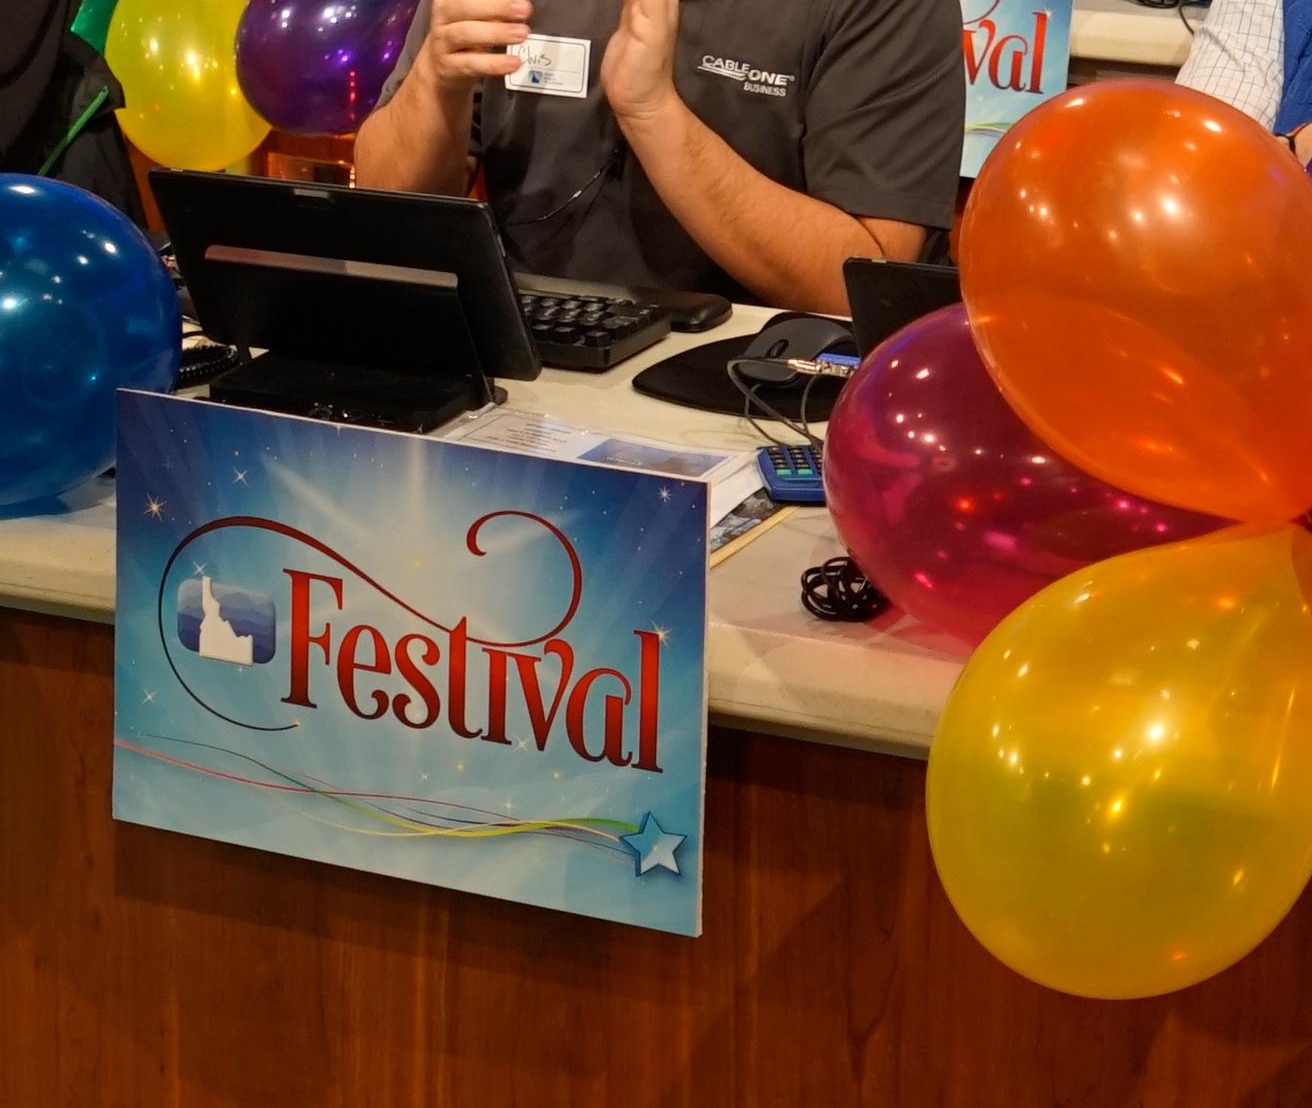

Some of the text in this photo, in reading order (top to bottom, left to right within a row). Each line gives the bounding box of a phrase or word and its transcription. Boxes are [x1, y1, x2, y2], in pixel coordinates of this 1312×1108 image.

[702, 55, 750, 73] CABLE
[743, 81, 787, 97] BUSINESS
[280, 567, 664, 774] Festival
